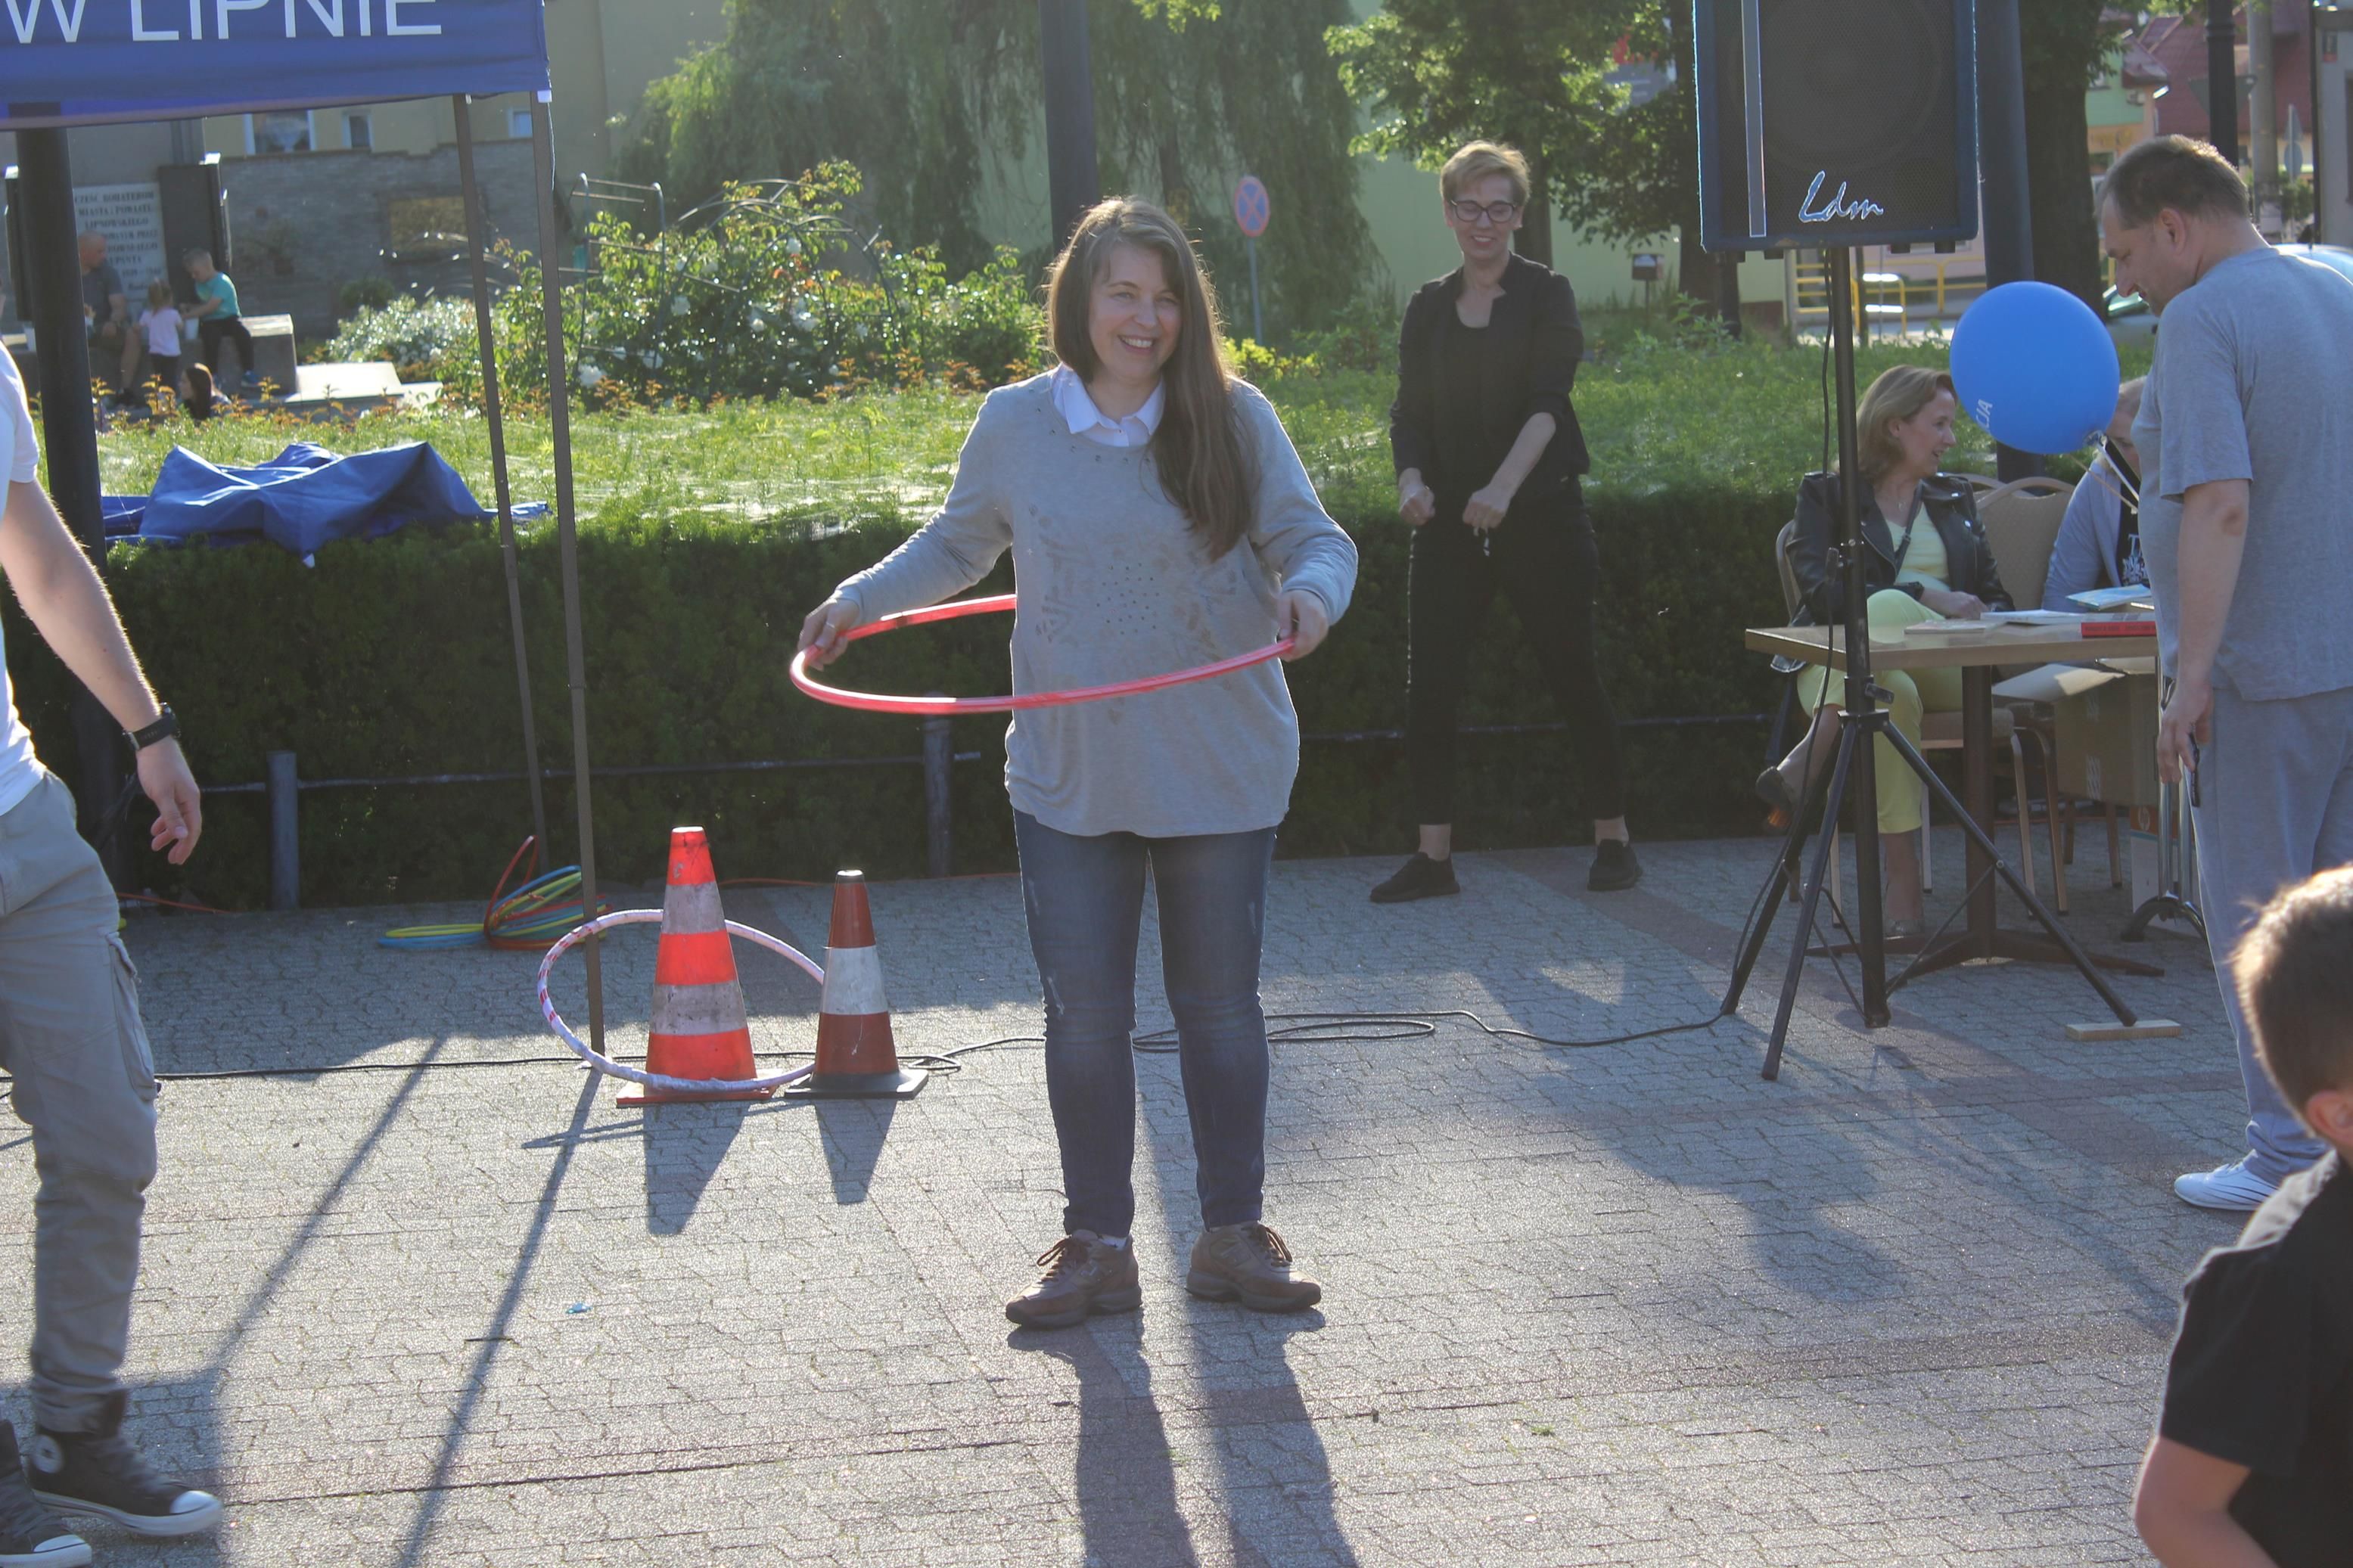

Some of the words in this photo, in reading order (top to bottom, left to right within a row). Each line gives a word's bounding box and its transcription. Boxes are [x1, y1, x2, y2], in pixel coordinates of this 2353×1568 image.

[5, 0, 85, 44] W
[130, 0, 442, 42] LIPNIE
[1798, 169, 1884, 223] Ldm
